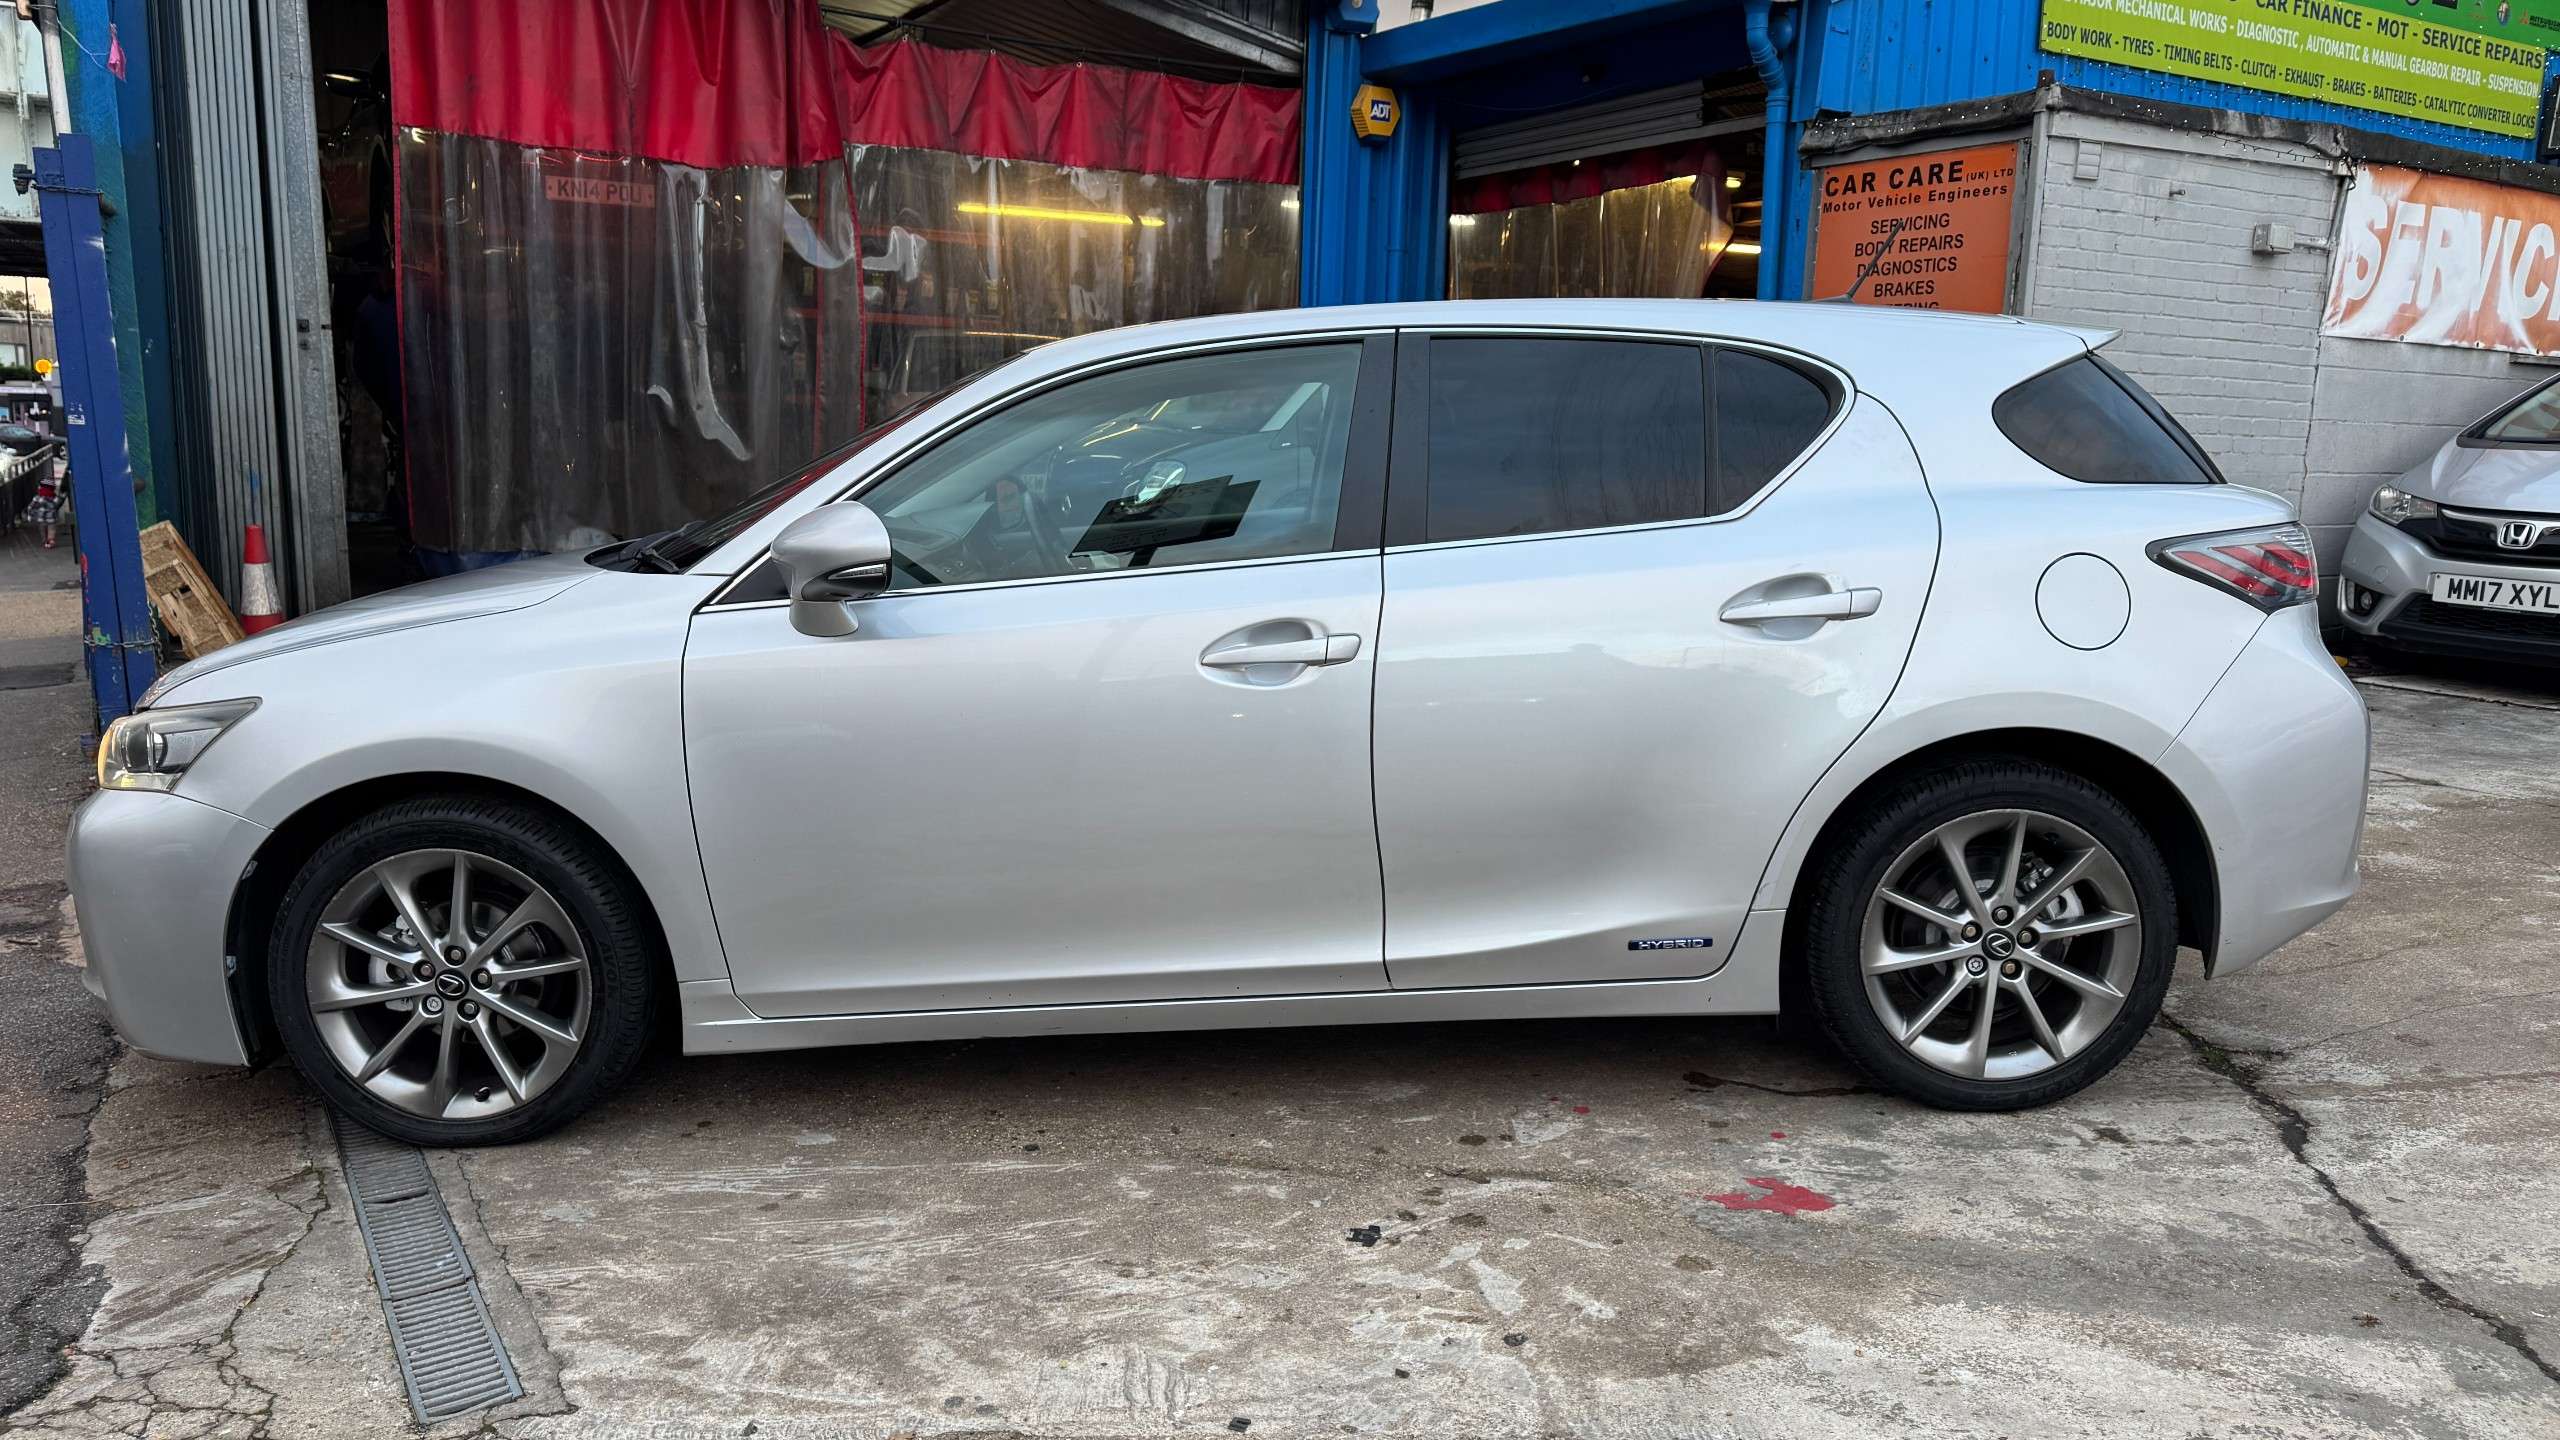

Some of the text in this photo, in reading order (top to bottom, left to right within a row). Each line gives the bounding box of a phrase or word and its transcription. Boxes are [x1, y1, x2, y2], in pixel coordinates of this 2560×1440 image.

[2115, 0, 2186, 26] MECHANICAL
[2188, 9, 2228, 34] WORKS
[2306, 35, 2360, 62] AUTOMATIC
[2371, 52, 2408, 72] MANUAL
[2410, 60, 2449, 80] GEARBOX
[2450, 65, 2481, 86] REPAIR
[2487, 74, 2540, 98] SUSPENSION
[2293, 0, 2362, 30] FINANCE
[2377, 17, 2409, 40] MOT
[2422, 28, 2481, 56] SERVICE
[2485, 42, 2543, 70] REPAIRS
[2047, 21, 2536, 129] BODY WORK TYRES TIMING BELTS CLUTCH EXHAUST BRAKES BATTERIES CATALYTIC CONVERTER LOCKS
[1371, 103, 1392, 119] ADT
[1825, 160, 2015, 198] CAR CARE (UK) LTD
[1823, 185, 2008, 214] Motor Vehicle Engineers
[1870, 212, 1950, 235] SERVICING
[1898, 233, 1964, 254] REPAIRS
[2340, 194, 2560, 320] SERVIC
[1857, 256, 1958, 278] DAGNOSTICS
[1873, 280, 1935, 298] BRAKES
[2447, 577, 2559, 609] MM17 XYL
[1638, 939, 1704, 950] HYBRID
